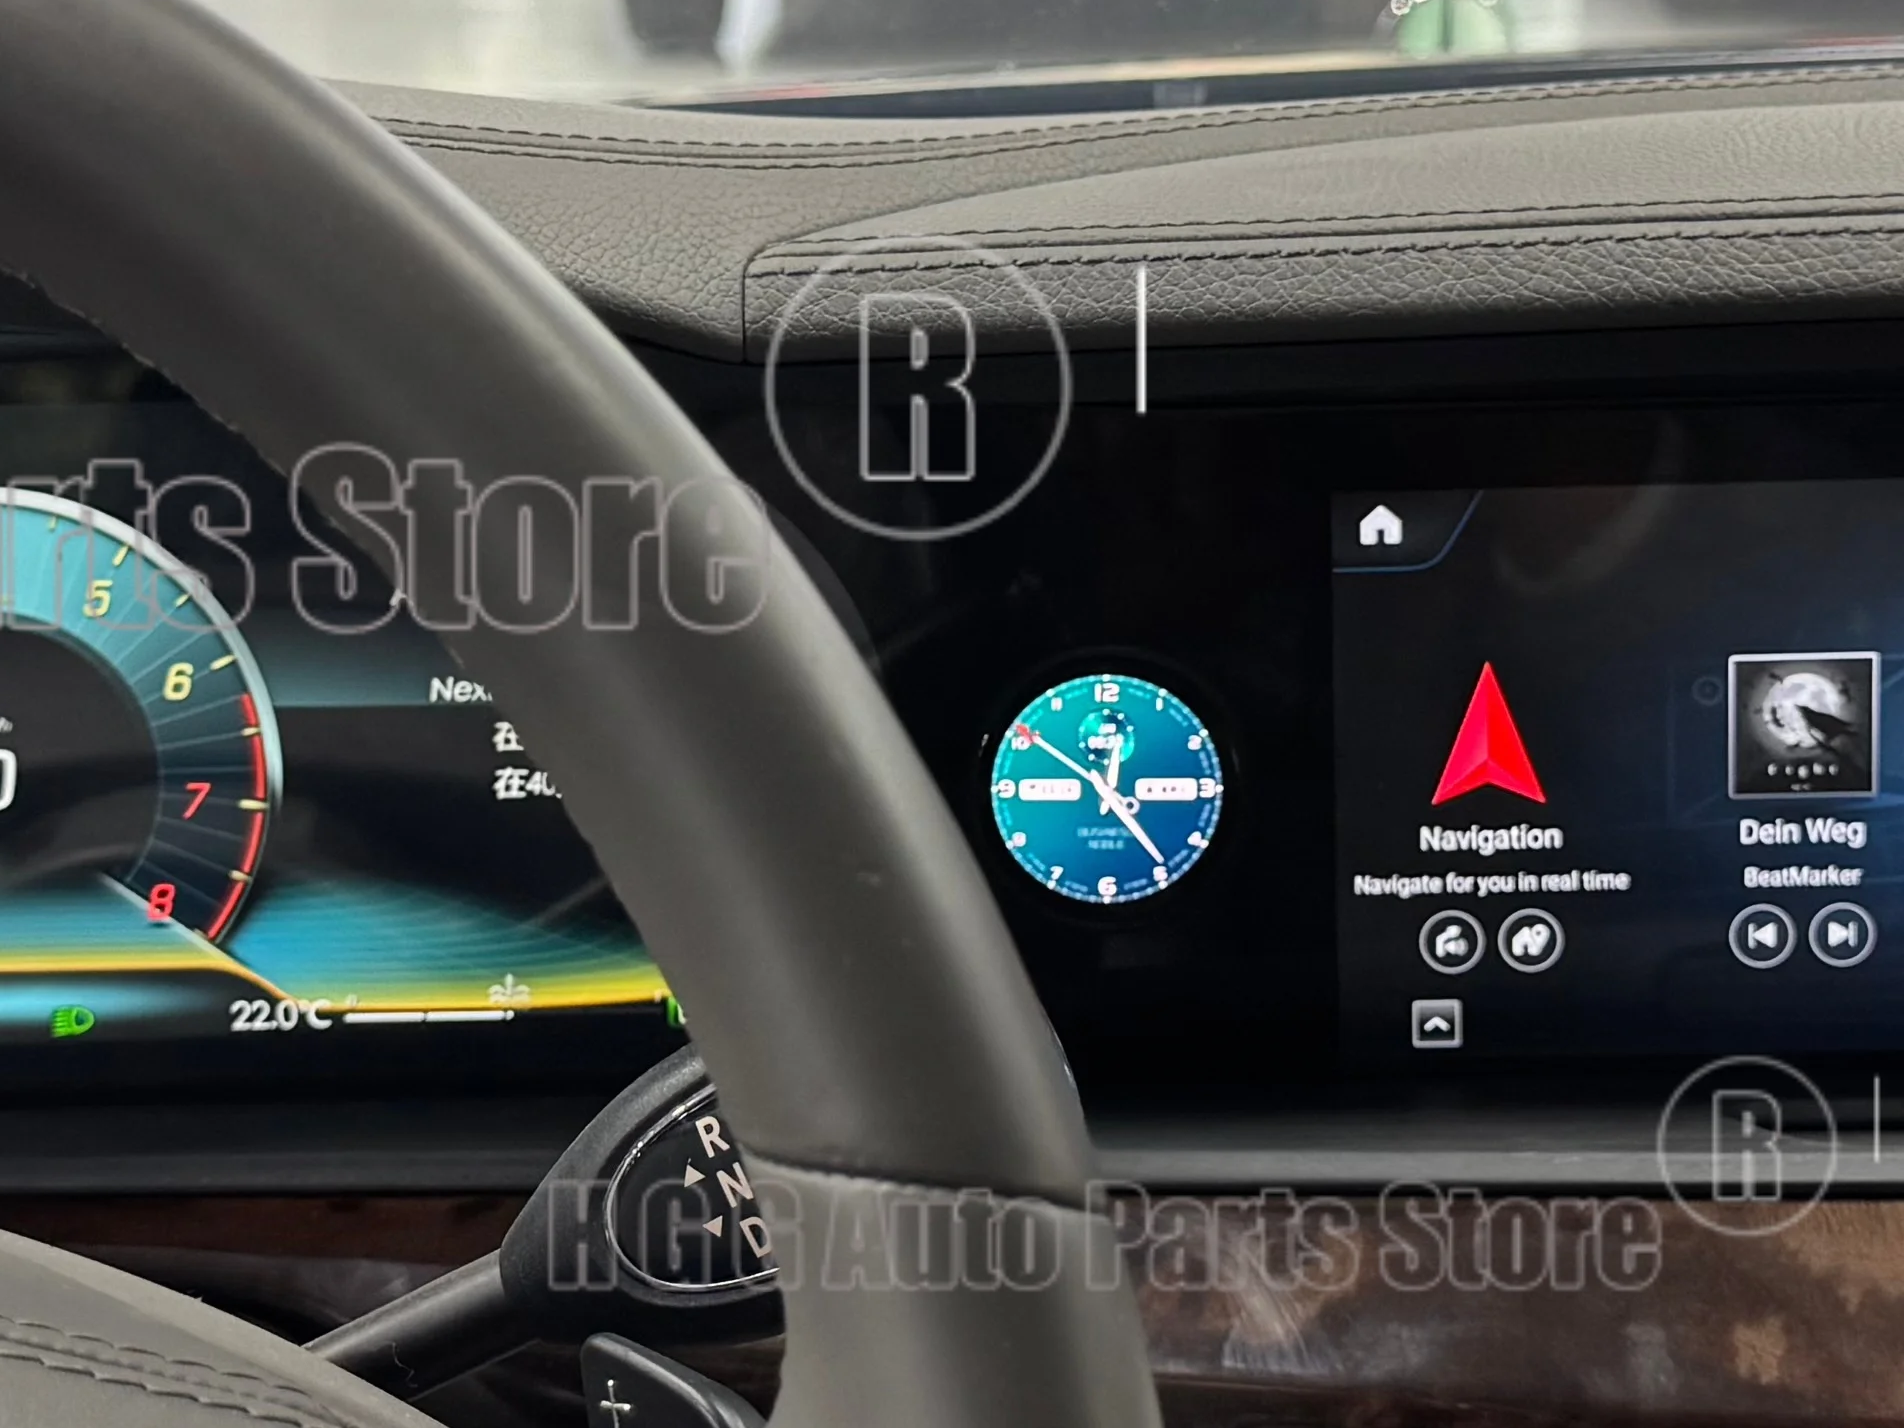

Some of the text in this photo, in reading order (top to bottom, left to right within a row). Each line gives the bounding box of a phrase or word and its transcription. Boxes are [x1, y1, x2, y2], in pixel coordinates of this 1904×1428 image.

[82, 579, 112, 618] 5
[162, 661, 194, 701] 6
[428, 675, 494, 703] Nex
[1094, 683, 1120, 703] 12
[182, 782, 212, 820] 7
[1419, 824, 1564, 856] Navigation
[1739, 817, 1868, 849] Dein Weg
[1097, 876, 1117, 896] 6
[1353, 869, 1632, 899] Navigate for you in real time
[1743, 864, 1864, 888] BeatMarker
[147, 882, 176, 923] 8
[695, 1115, 730, 1159] R
[716, 1162, 755, 1208] N
[739, 1216, 774, 1259] D
